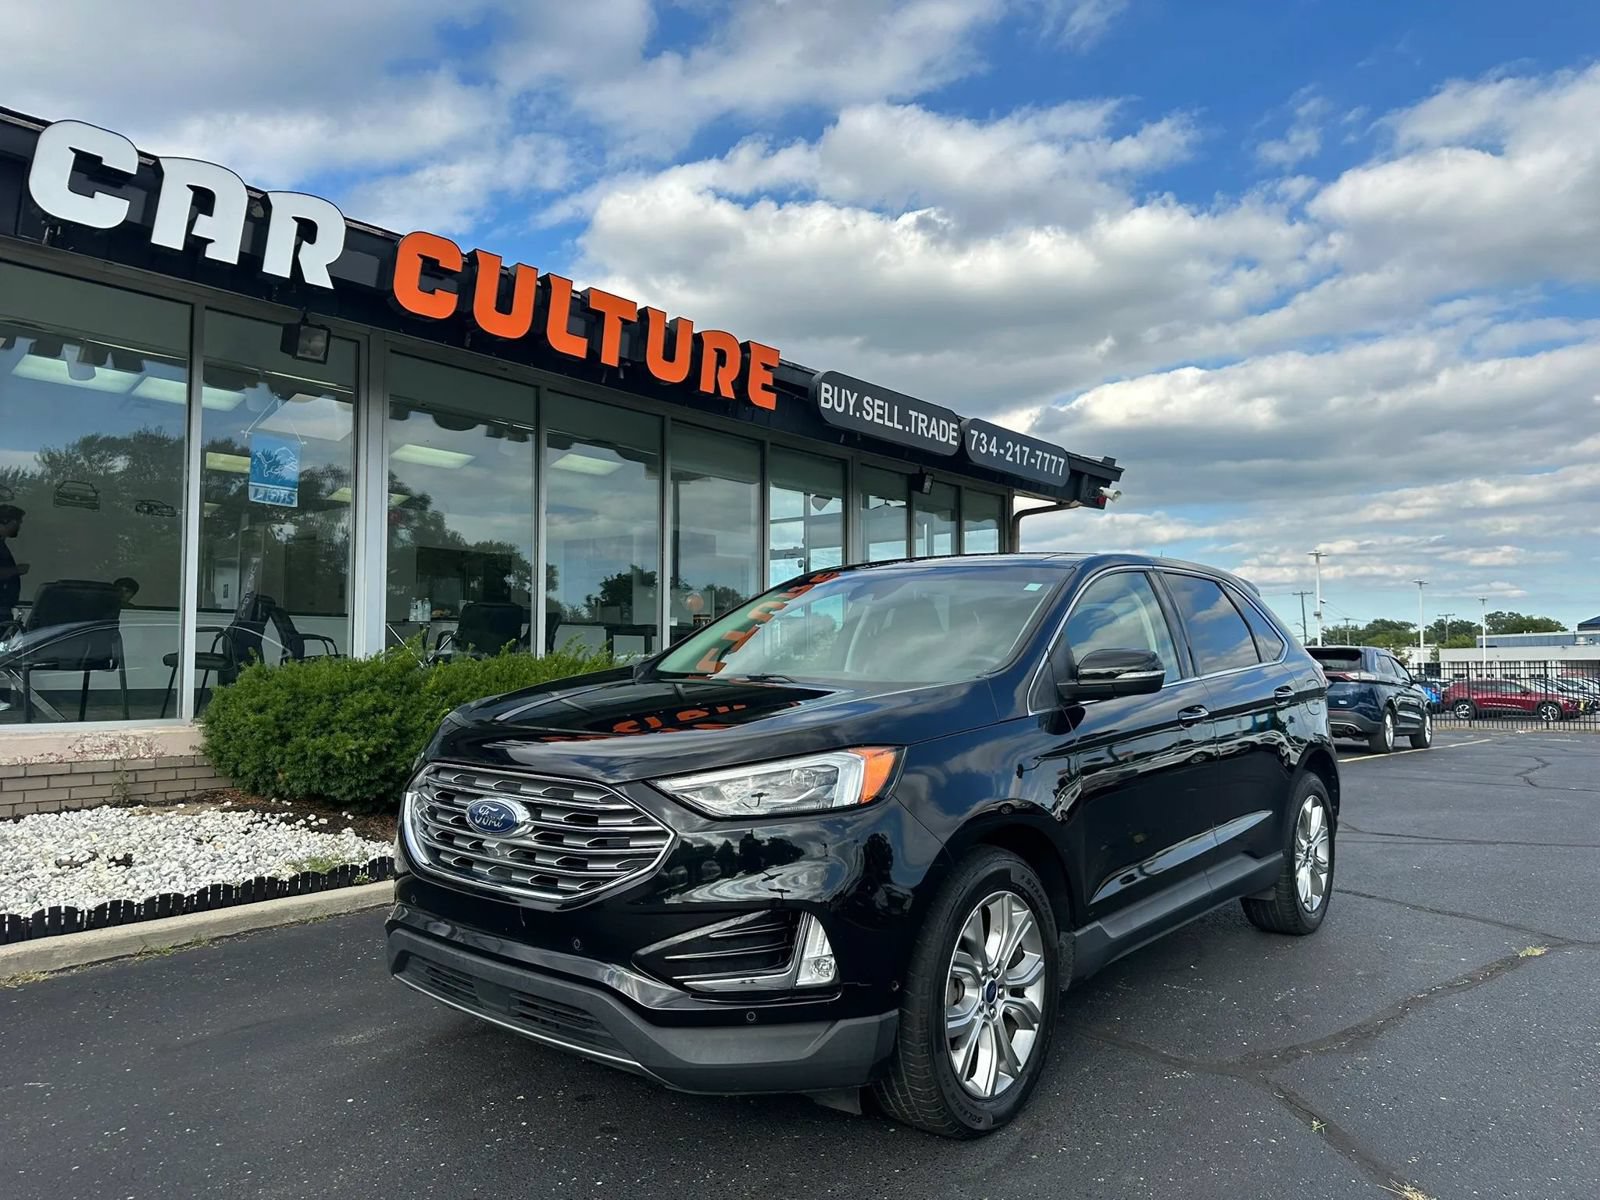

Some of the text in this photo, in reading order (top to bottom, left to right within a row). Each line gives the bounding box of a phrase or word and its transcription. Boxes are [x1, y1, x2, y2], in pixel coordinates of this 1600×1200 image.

[28, 119, 780, 411] CAR CULTURE
[970, 429, 1065, 477] 734-217-7777
[474, 804, 506, 828] Ford
